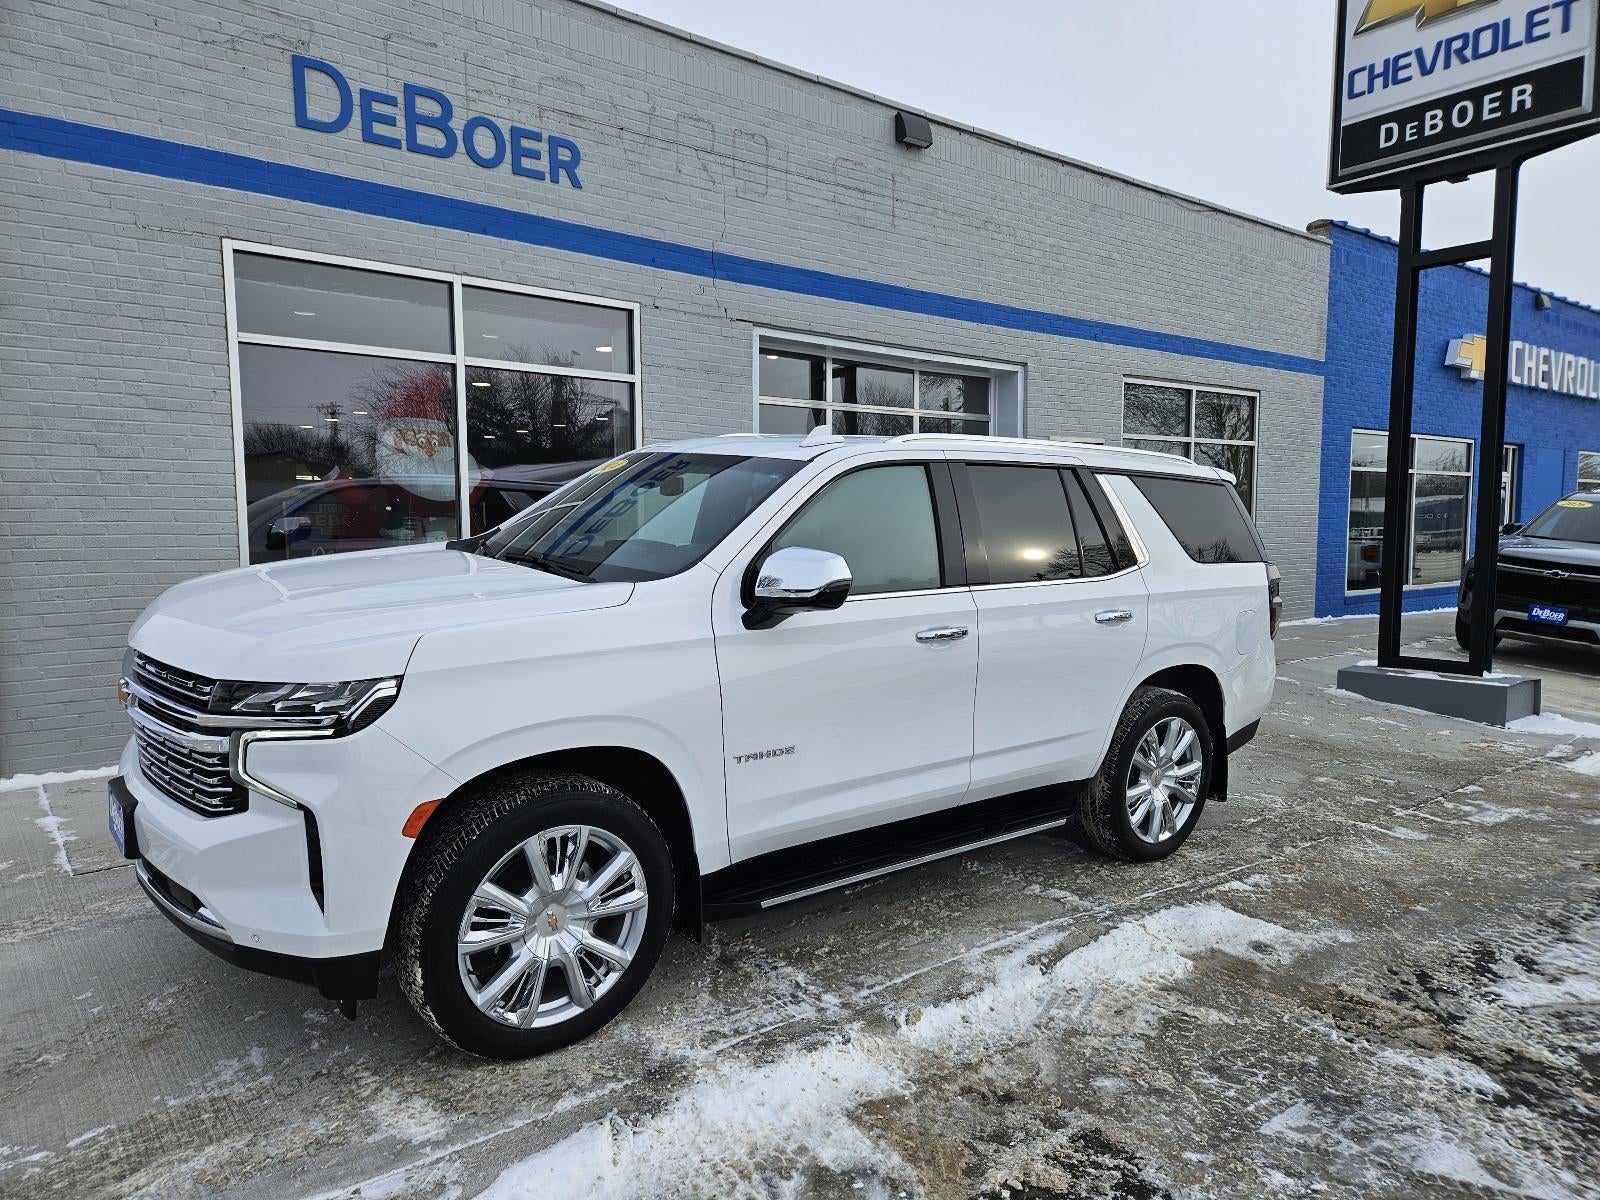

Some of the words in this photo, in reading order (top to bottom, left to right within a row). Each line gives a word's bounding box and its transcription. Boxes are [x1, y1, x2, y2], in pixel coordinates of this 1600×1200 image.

[1347, 0, 1580, 100] CHEVROLET
[292, 54, 583, 189] DEBOER
[1379, 83, 1534, 149] DEBOER
[1508, 340, 1600, 399] CHEVROL
[733, 745, 796, 764] TAHOE
